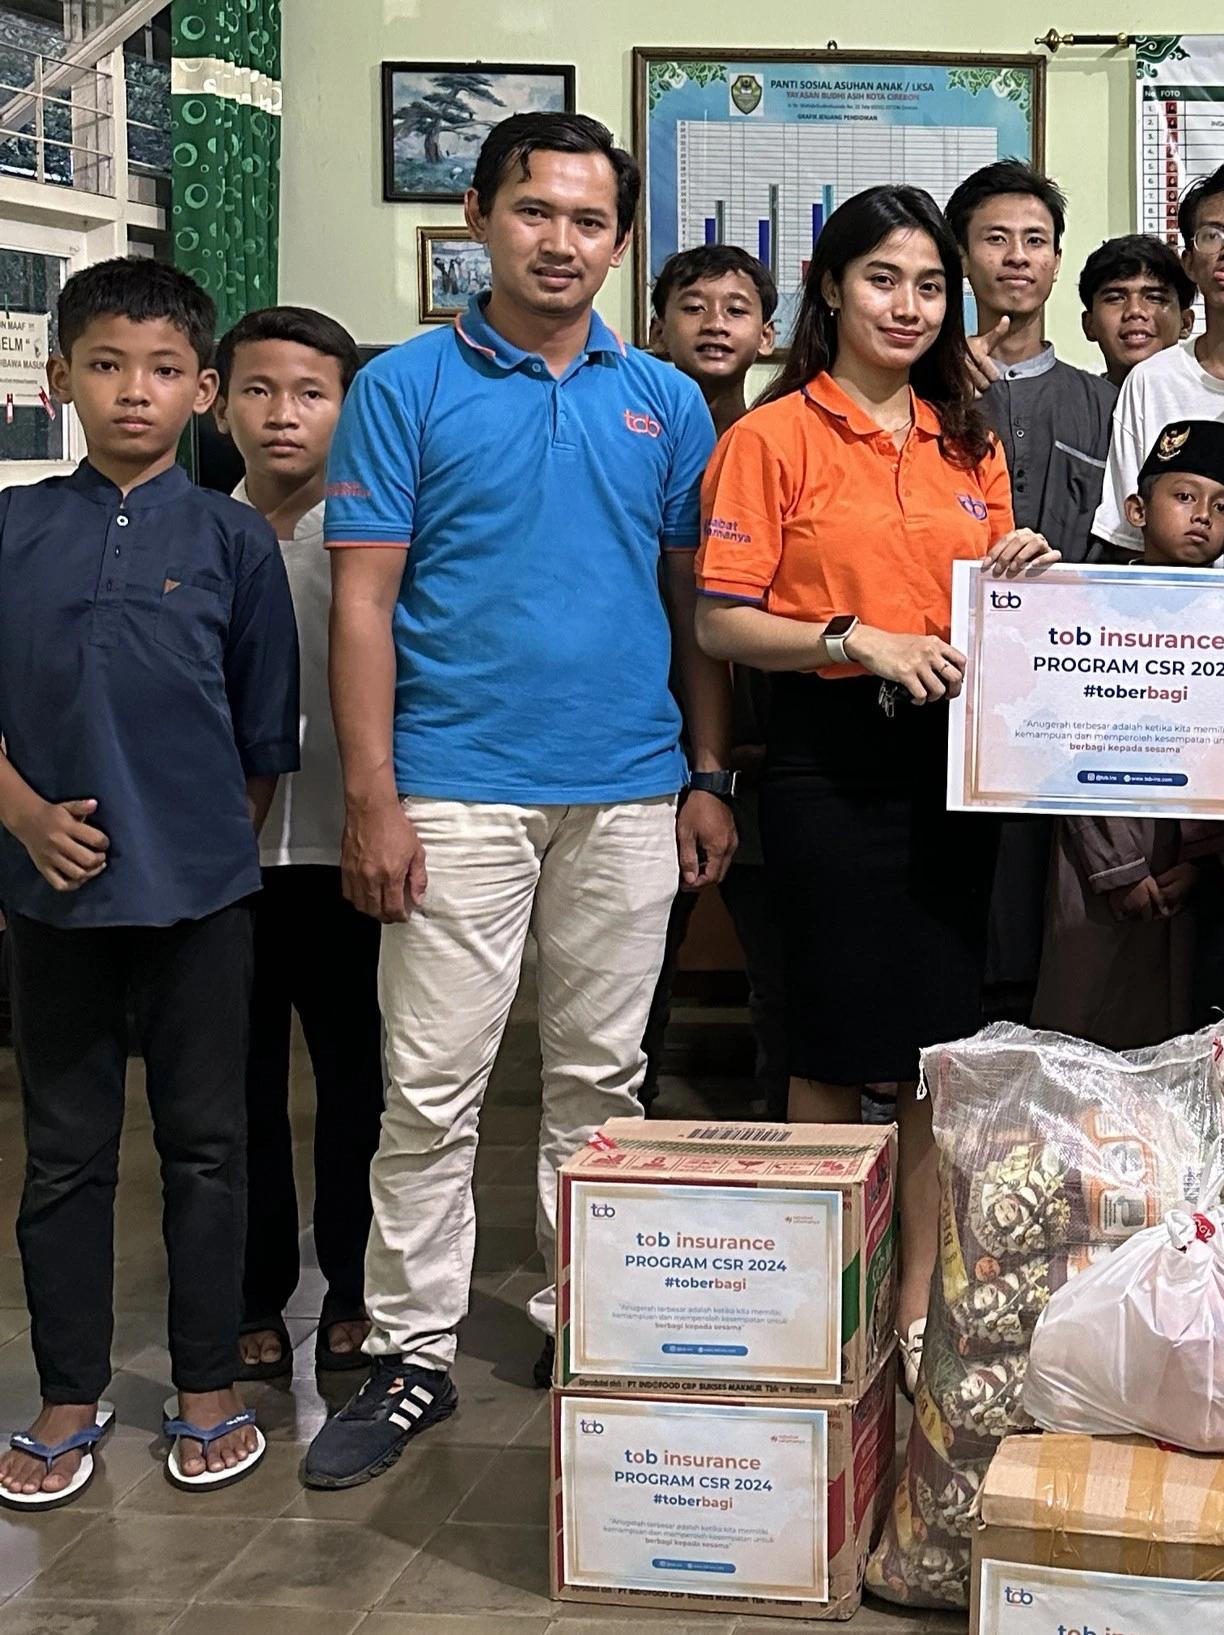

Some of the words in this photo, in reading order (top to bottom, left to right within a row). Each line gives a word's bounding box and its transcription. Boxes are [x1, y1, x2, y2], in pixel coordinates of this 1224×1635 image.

[770, 80, 798, 89] PANTI
[800, 81, 832, 90] SOSIAL
[834, 81, 874, 91] ASUHAN
[876, 82, 902, 91] ANAK
[912, 83, 935, 92] LKSA
[786, 91, 820, 99] YAYASAN
[887, 93, 919, 101] CIREBON
[1160, 90, 1181, 98] FOTO
[8, 320, 26, 330] MAAF
[0, 337, 23, 352] ELM
[0, 359, 21, 368] BAWA
[23, 360, 45, 370] MASUK
[624, 409, 661, 438] tob
[957, 493, 988, 521] tb
[990, 590, 1022, 609] tob
[1048, 627, 1092, 646] tob
[1034, 656, 1139, 674] PROGRAM
[1145, 660, 1185, 676] CSR
[1083, 684, 1188, 704] #toberbagi
[1073, 721, 1110, 731] terbesar
[1112, 722, 1143, 732] adalah
[1145, 723, 1173, 733] ketika
[1175, 724, 1191, 733] kita
[1015, 731, 1073, 741] kemampuan
[1074, 732, 1092, 741] dan
[1094, 733, 1152, 743] memperoleh
[1155, 735, 1211, 745] kesempatan
[1070, 743, 1106, 753] berbagi
[1108, 744, 1143, 753] kepada
[591, 1203, 615, 1218] tob
[636, 1232, 670, 1248] tob
[676, 1232, 776, 1251] insurance
[625, 1255, 707, 1269] PROGRAM
[712, 1258, 743, 1270] CSR
[748, 1259, 787, 1272] 2024
[665, 1277, 747, 1292] #toberbagi
[627, 1380, 637, 1388] PT
[580, 1419, 604, 1434] tob
[624, 1449, 658, 1465] tob
[664, 1450, 761, 1471] insurance
[615, 1471, 694, 1488] PROGRAM
[699, 1477, 730, 1490] CSR
[734, 1478, 773, 1492] 2024
[653, 1494, 733, 1511] #toberbagi
[1004, 1586, 1033, 1605] tob
